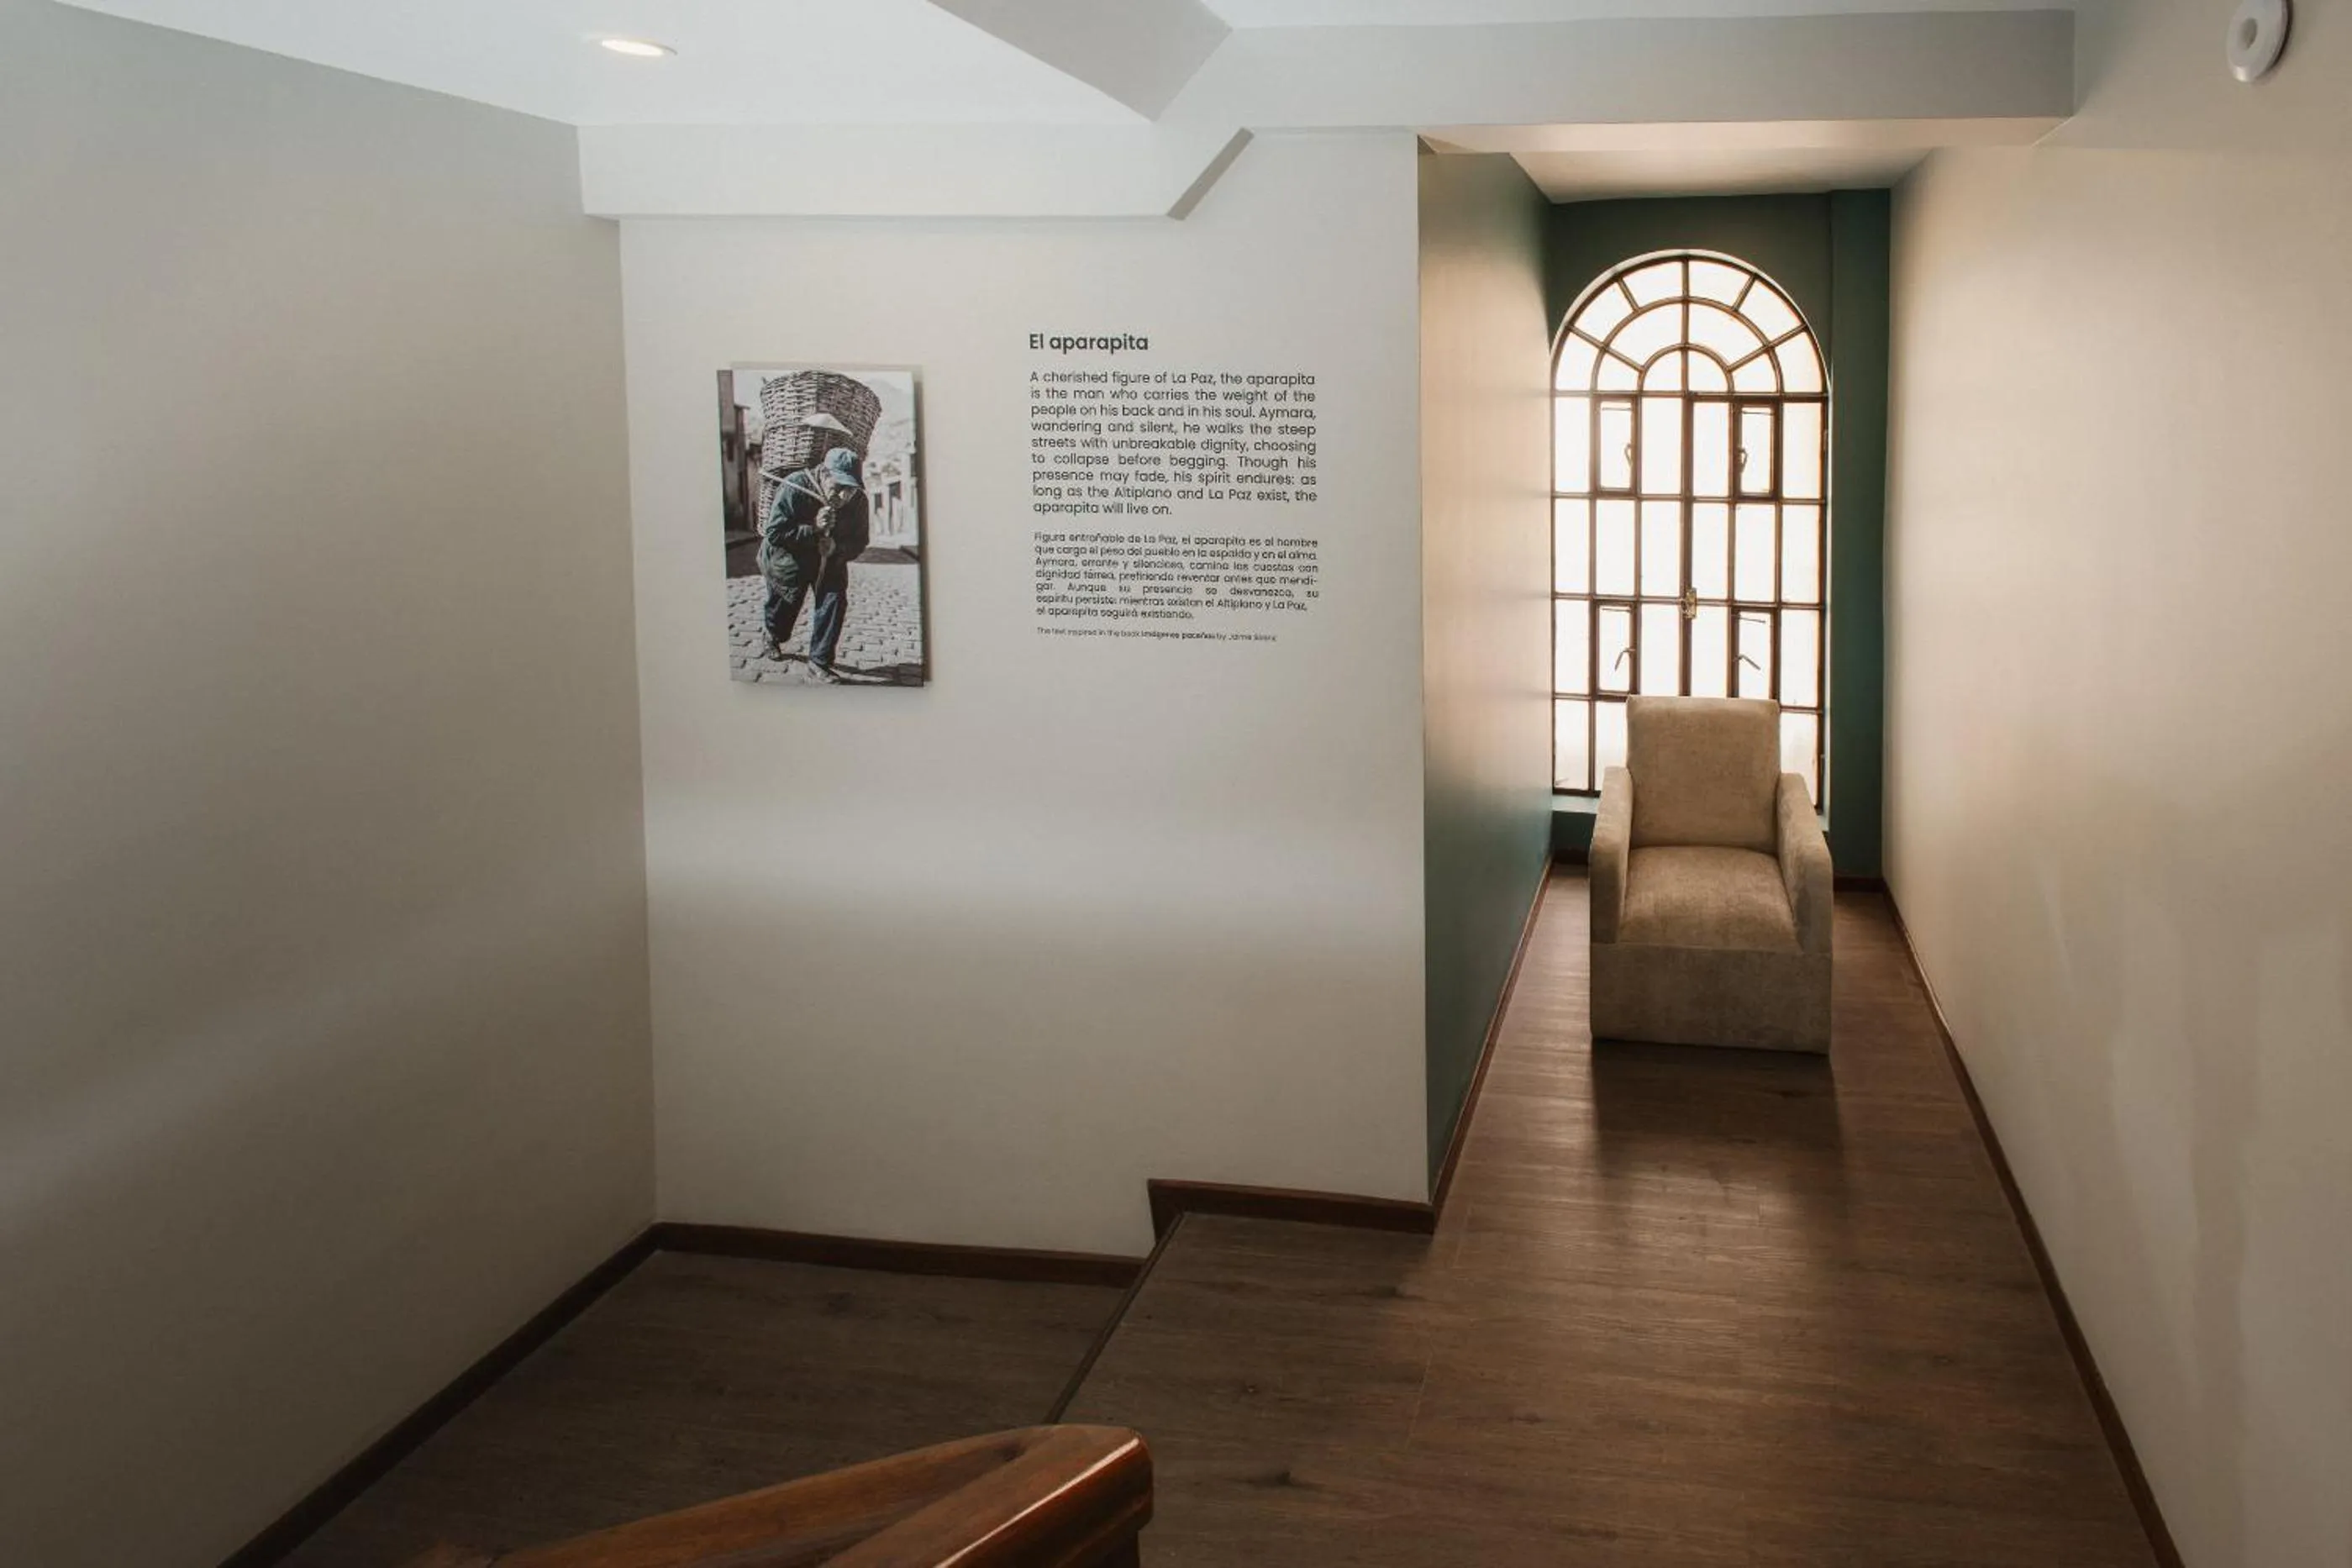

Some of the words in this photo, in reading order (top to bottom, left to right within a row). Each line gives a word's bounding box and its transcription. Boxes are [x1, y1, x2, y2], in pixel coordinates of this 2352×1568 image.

[1029, 334, 1044, 349] El
[1049, 334, 1148, 354] aparapita
[1029, 371, 1039, 381] A
[1042, 371, 1108, 382] cherished
[1112, 372, 1150, 385] figure
[1154, 372, 1167, 382] of
[1171, 373, 1187, 382] La
[1191, 373, 1217, 384] Paz,
[1220, 373, 1242, 383] the
[1245, 373, 1314, 387] aparapita
[1030, 387, 1040, 397] is
[1045, 387, 1067, 397] the
[1073, 390, 1104, 398] man
[1109, 388, 1138, 398] who
[1143, 389, 1189, 399] carries
[1194, 389, 1217, 399] the
[1222, 390, 1267, 403] weight
[1274, 390, 1286, 400] of
[1293, 391, 1316, 401] the
[1031, 404, 1076, 418] people
[1080, 407, 1097, 415] on
[1100, 405, 1118, 415] his
[1122, 405, 1155, 415] back
[1158, 406, 1184, 416] and
[1187, 406, 1198, 416] in
[1202, 406, 1222, 416] his
[1225, 407, 1255, 417] soul.
[1259, 407, 1316, 420] Aymara,
[1031, 420, 1101, 434] wandering
[1108, 421, 1134, 432] and
[1139, 422, 1177, 434] silent,
[1183, 423, 1200, 433] he
[1205, 423, 1244, 433] walks
[1250, 424, 1271, 434] the
[1277, 424, 1316, 437] steep
[1031, 436, 1076, 447] streets
[1080, 437, 1108, 448] with
[1113, 438, 1197, 449] unbreakable
[1200, 439, 1249, 453] dignity,
[1254, 440, 1316, 454] choosing
[1032, 453, 1045, 463] to
[1053, 453, 1109, 467] collapse
[1118, 455, 1160, 465] before
[1169, 455, 1228, 469] begging.
[1238, 456, 1287, 470] Though
[1297, 457, 1316, 467] his
[1032, 471, 1093, 482] presence
[1100, 473, 1129, 483] may
[1134, 471, 1169, 482] fade,
[1173, 471, 1192, 481] his
[1198, 472, 1230, 485] spirit
[1236, 472, 1294, 484] endures:
[1300, 476, 1316, 484] as
[1033, 485, 1062, 498] long
[1066, 487, 1082, 496] as
[1087, 486, 1109, 497] the
[1114, 487, 1171, 501] Altiplano
[1176, 488, 1203, 498] and
[1208, 488, 1223, 499] La
[1229, 489, 1252, 499] Paz
[1256, 490, 1289, 502] exist,
[1295, 491, 1318, 501] the
[1033, 501, 1099, 515] aparapita
[1102, 502, 1123, 513] will
[1126, 503, 1148, 513] live
[1151, 506, 1171, 514] on.
